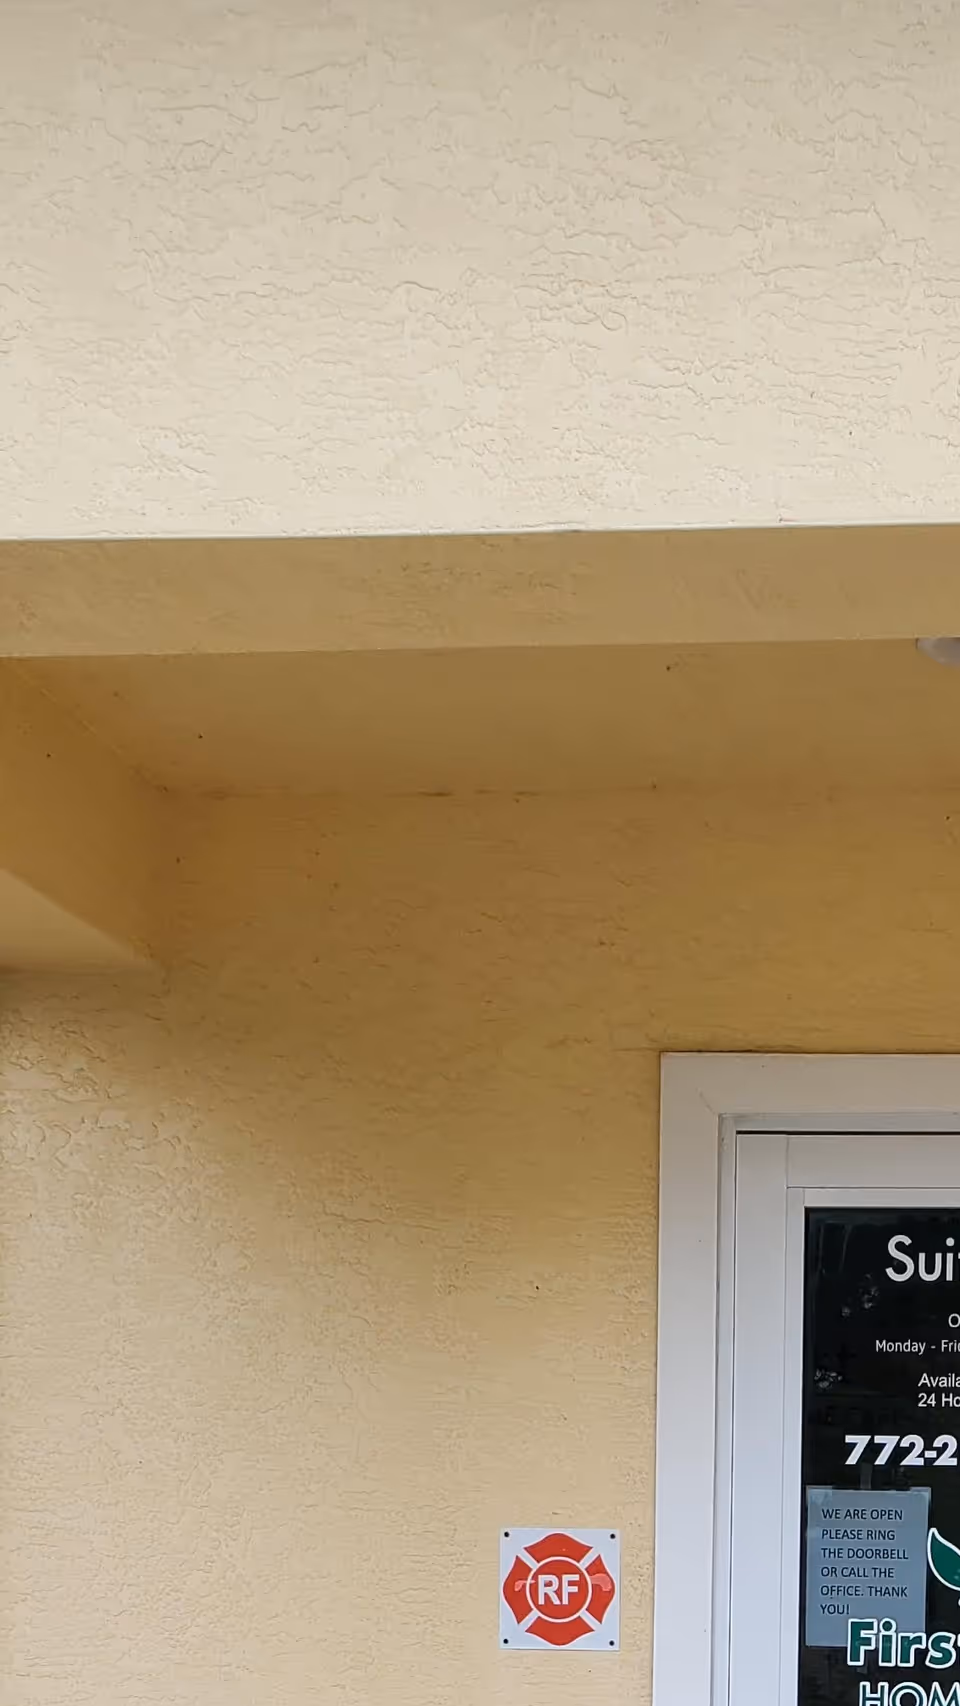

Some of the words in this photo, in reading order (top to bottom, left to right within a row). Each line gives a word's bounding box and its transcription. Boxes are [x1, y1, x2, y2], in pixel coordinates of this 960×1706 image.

[875, 1339, 926, 1355] Monday
[918, 1394, 937, 1407] 24
[821, 1508, 841, 1520] WE
[844, 1509, 867, 1520] ARE
[870, 1509, 903, 1521] OPEN
[821, 1528, 863, 1540] PLEASE
[866, 1529, 895, 1541] RING
[821, 1548, 843, 1559] THE
[847, 1548, 909, 1560] DOORBELL
[820, 1567, 838, 1578] OR
[841, 1567, 868, 1578] CALL
[872, 1567, 894, 1578] THE
[537, 1574, 580, 1605] RF
[820, 1584, 864, 1597] OFFICE.
[867, 1585, 908, 1598] THANK
[820, 1603, 850, 1615] YOU!
